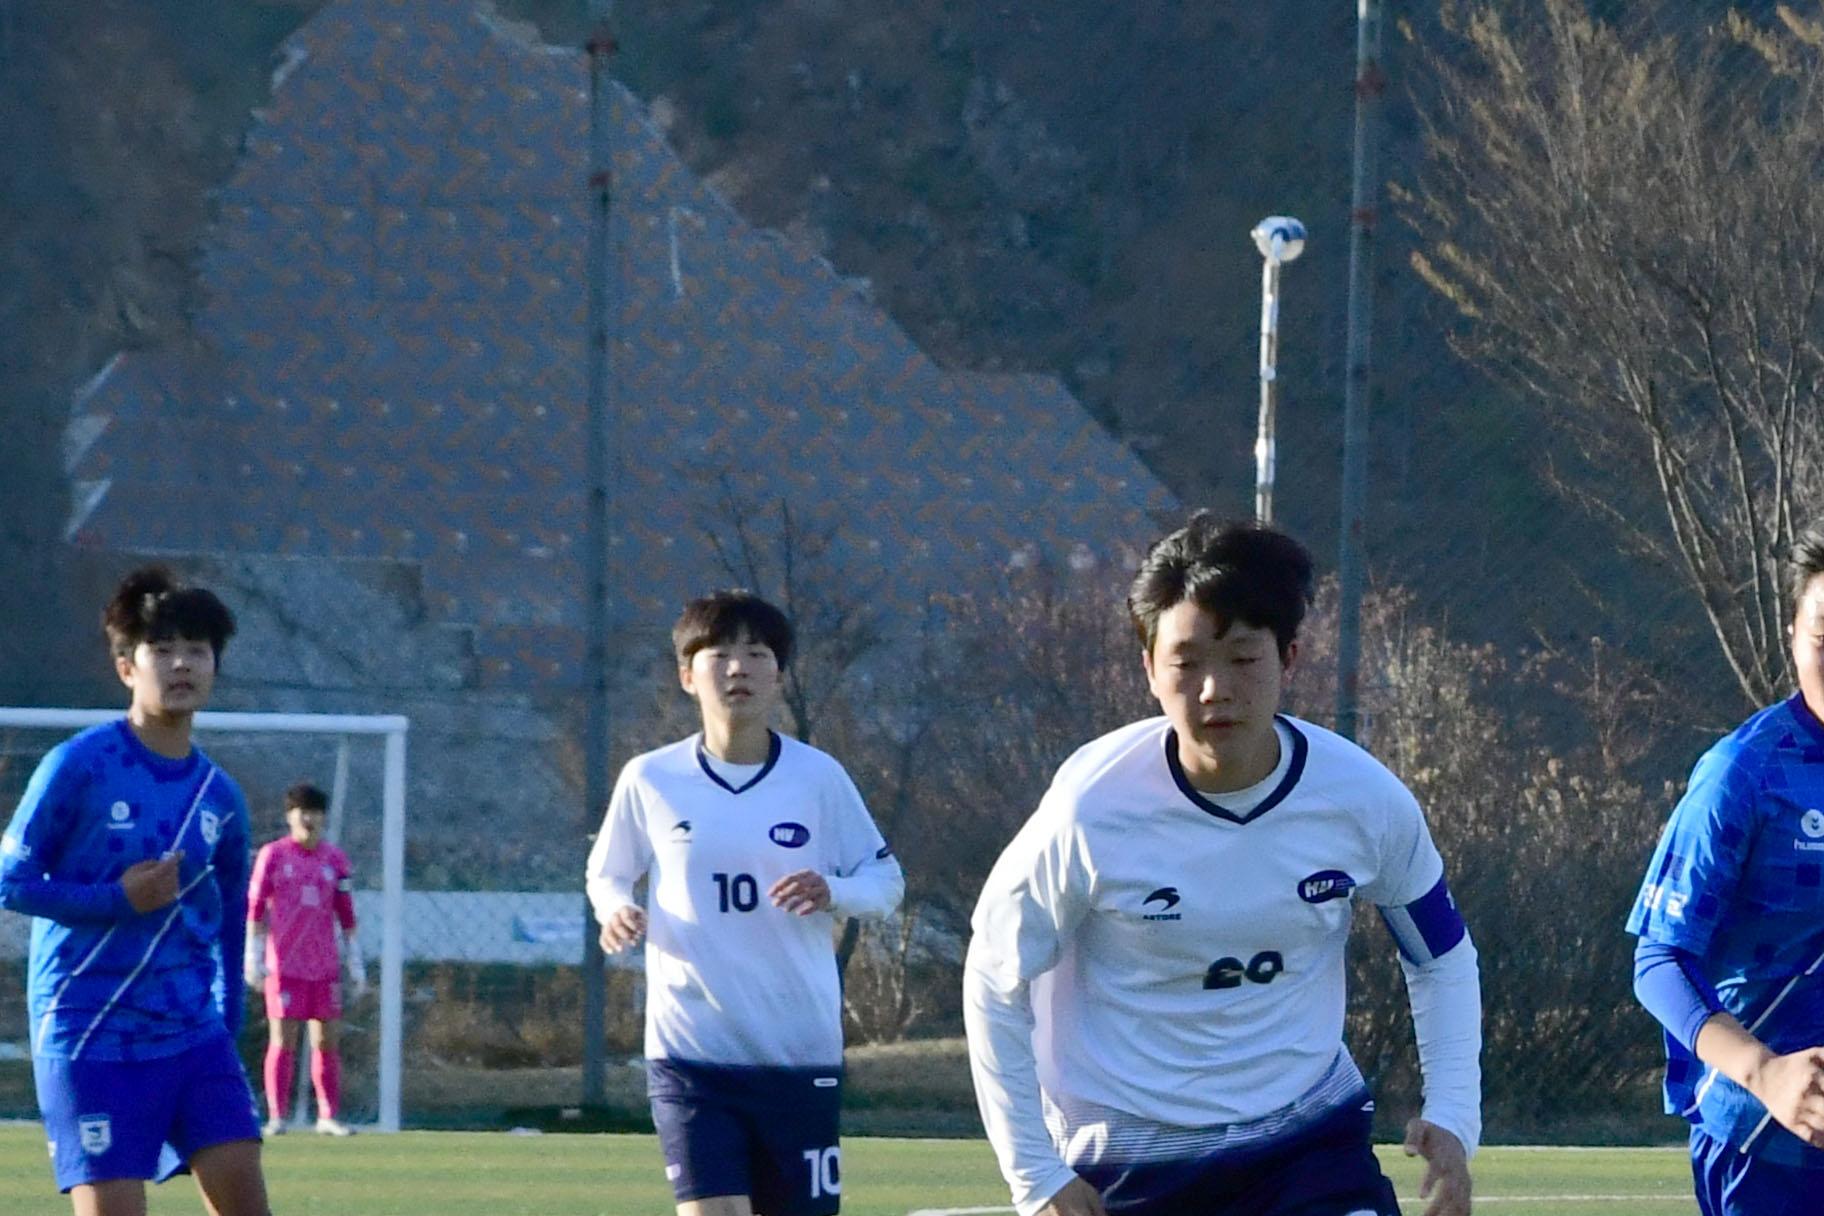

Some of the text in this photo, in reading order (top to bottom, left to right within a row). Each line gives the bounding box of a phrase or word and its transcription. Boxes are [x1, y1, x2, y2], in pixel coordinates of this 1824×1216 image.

[712, 873, 760, 913] 10
[1202, 956, 1284, 990] 20
[803, 1145, 842, 1199] 10
